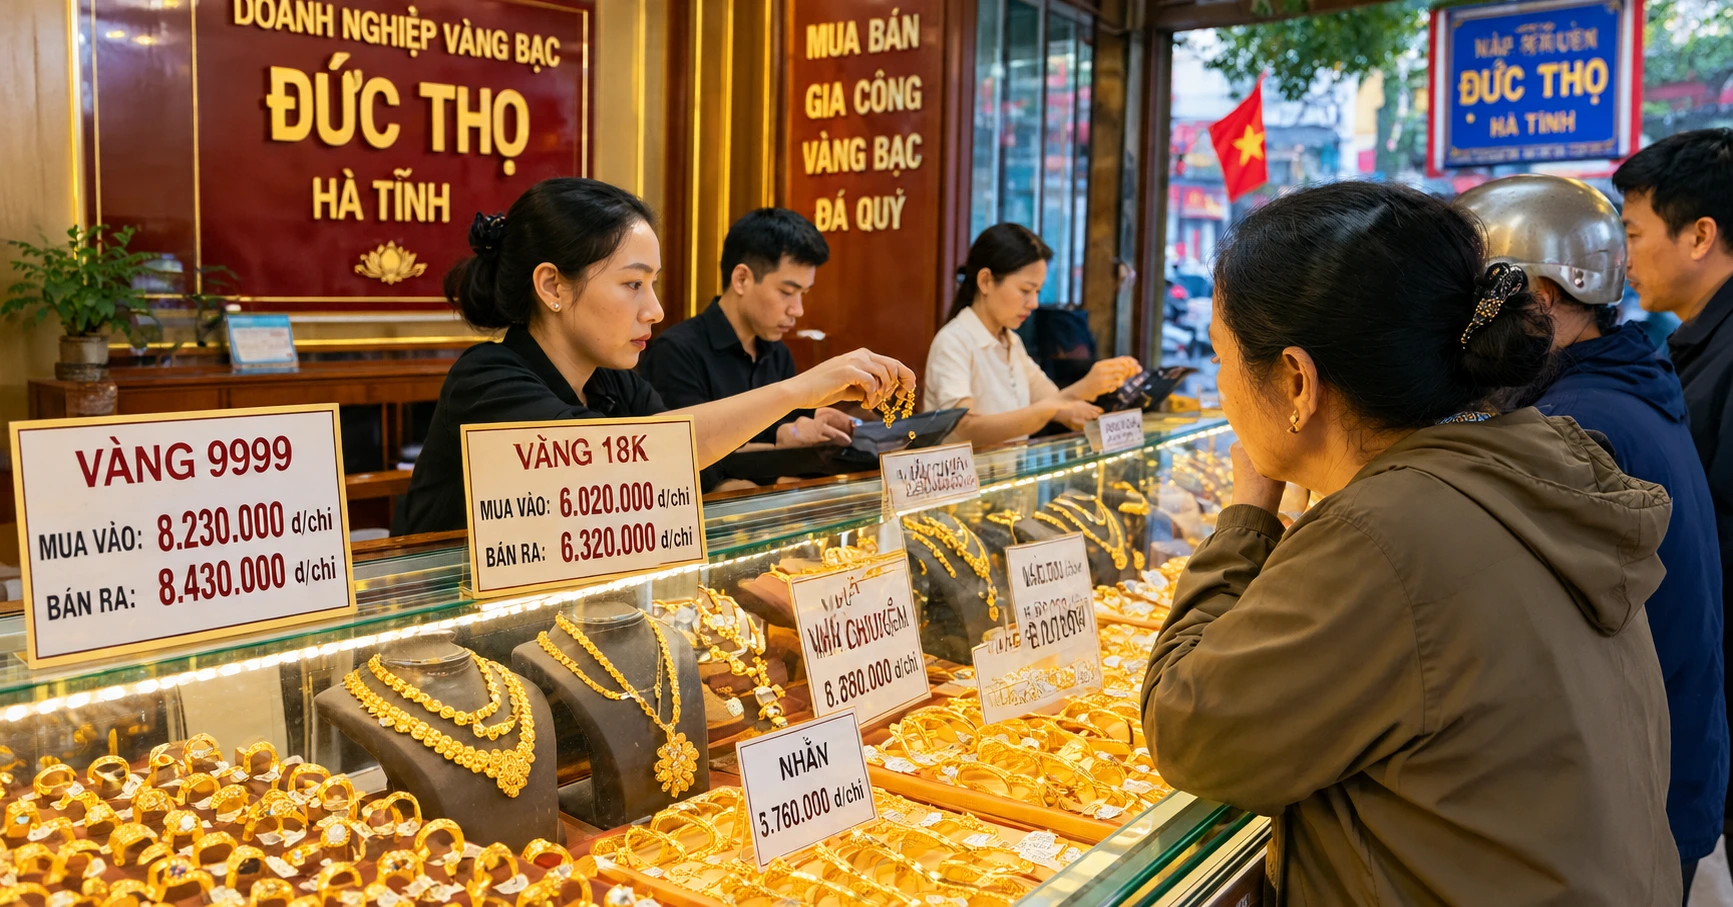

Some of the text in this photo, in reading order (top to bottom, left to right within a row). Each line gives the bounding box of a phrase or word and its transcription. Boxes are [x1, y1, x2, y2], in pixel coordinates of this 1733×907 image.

[234, 0, 560, 73] DOANH NGHIỆP VÀNG BẠC
[806, 8, 920, 60] MUA BÁN
[805, 69, 922, 120] GIA CÔNG
[1537, 57, 1609, 105] THỌ
[266, 52, 530, 176] ĐỨC THỌ
[802, 131, 922, 177] VÀNG BẠC
[313, 167, 450, 223] HÀ TĨNH
[814, 188, 849, 232] ĐÁ
[75, 435, 292, 488] VÀNG 9999
[512, 434, 649, 471] VÀNG 18K
[480, 498, 514, 521] MUA
[516, 492, 551, 518] VÀO:
[559, 481, 654, 518] 6.020.000
[39, 530, 88, 561] MUA
[92, 520, 143, 554] VÀO:
[157, 501, 285, 552] 8.230.000
[486, 541, 517, 568] BÁN
[521, 542, 546, 564] RA:
[561, 522, 656, 563] 6.320.000
[47, 587, 92, 621] BÁN
[99, 586, 136, 613] RA:
[158, 553, 286, 606] 8.430.000
[759, 787, 831, 838] 5.760.000
